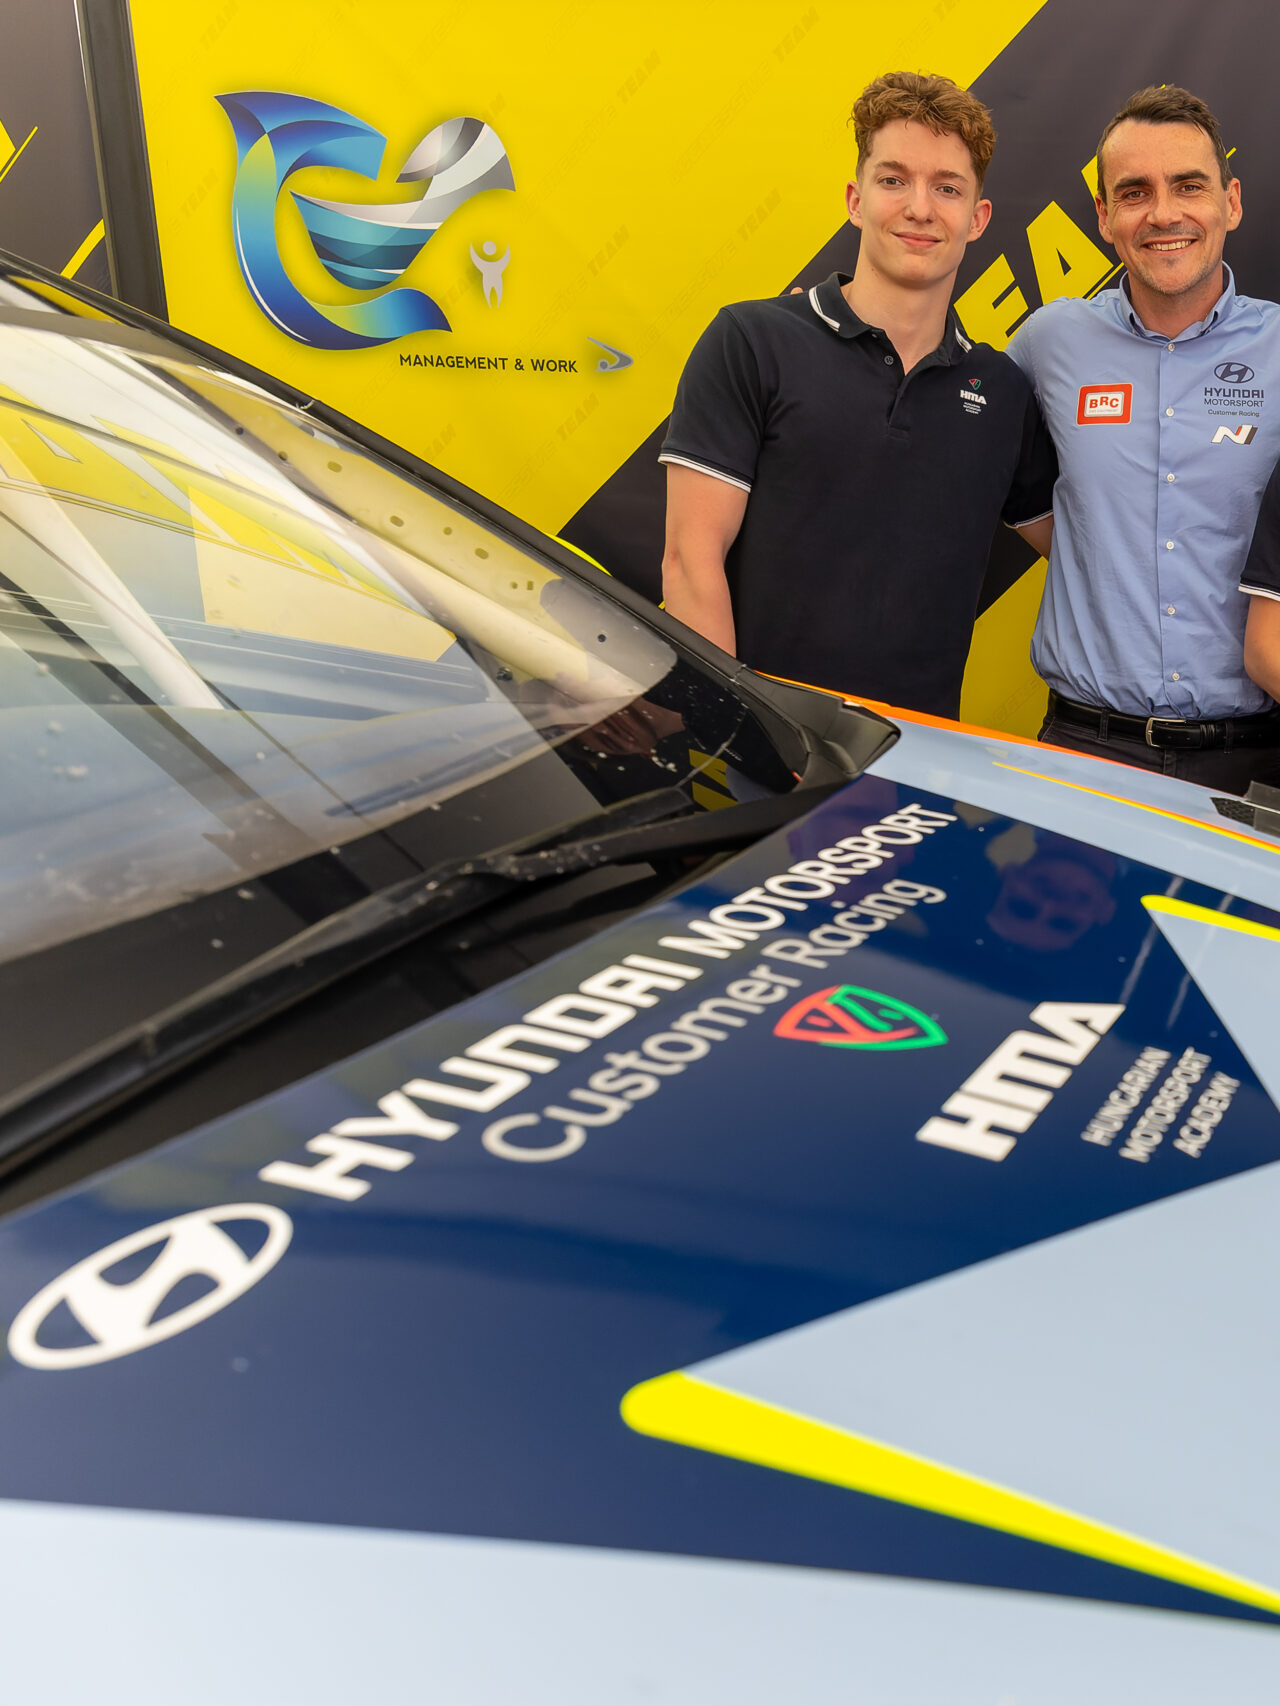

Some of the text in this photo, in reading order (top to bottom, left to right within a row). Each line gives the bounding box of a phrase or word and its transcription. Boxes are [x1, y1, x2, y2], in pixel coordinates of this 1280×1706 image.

[772, 5, 820, 63] TEAM
[617, 48, 661, 104] TEAM
[737, 187, 782, 241] TEAM
[587, 224, 630, 277] TEAM
[953, 155, 1114, 352] EA
[399, 353, 579, 373] MANAGEMENT & WORK
[555, 392, 600, 441] TEAM
[1089, 396, 1120, 409] BRC
[1203, 399, 1264, 408] MOTORSPORT
[1204, 387, 1265, 399] HYUNDAI
[1208, 409, 1260, 418] Customer Racing
[258, 802, 959, 1202] HYUNDAI MOTORSPORT
[480, 876, 948, 1164] Customer Racing
[915, 1000, 1127, 1163] HMA
[1080, 1045, 1173, 1147] HUNGARIAN
[1118, 1045, 1212, 1164] MOTORSPORT
[1173, 1070, 1241, 1159] ACADEMY
